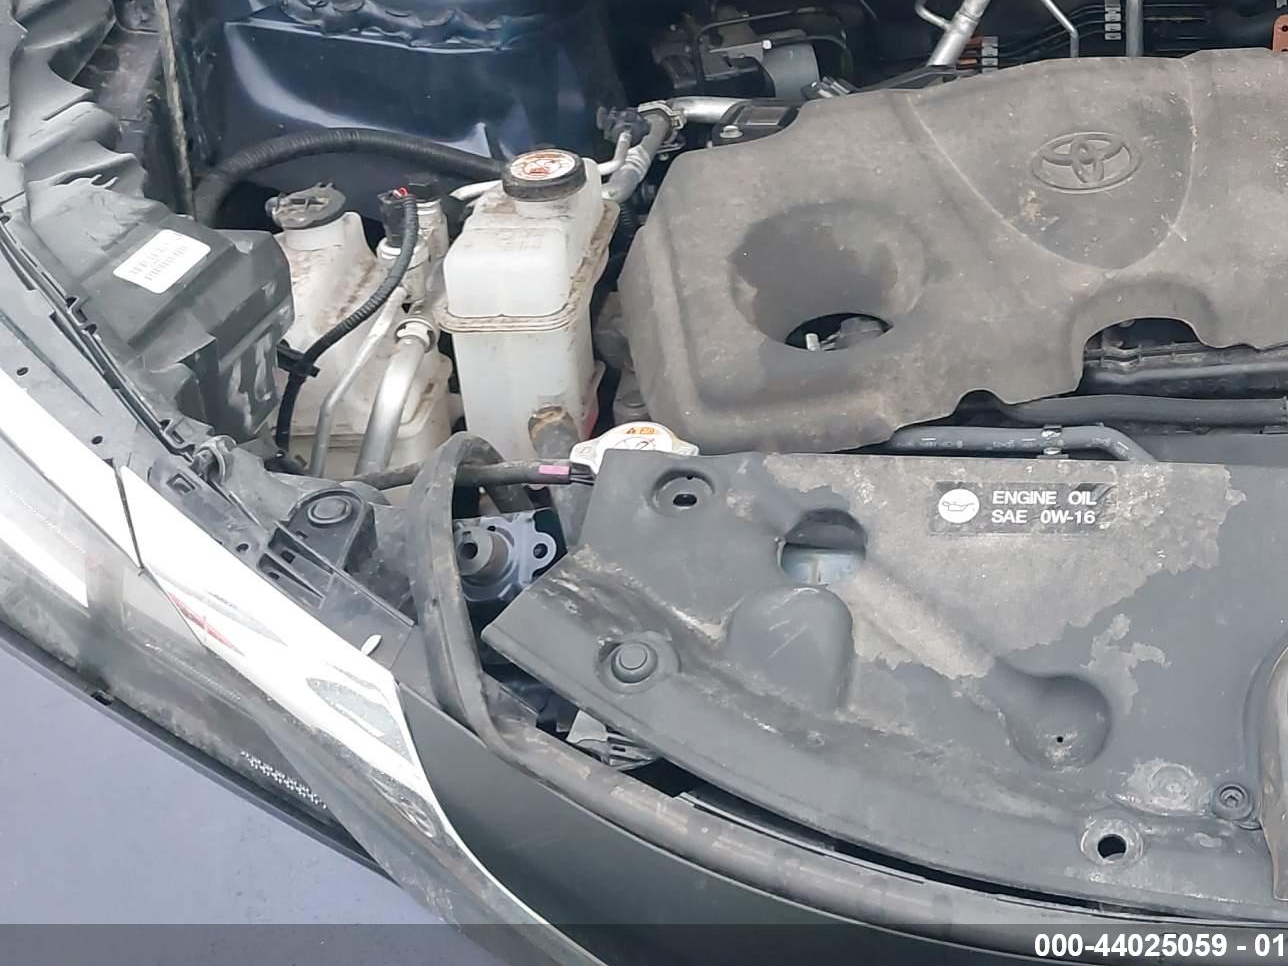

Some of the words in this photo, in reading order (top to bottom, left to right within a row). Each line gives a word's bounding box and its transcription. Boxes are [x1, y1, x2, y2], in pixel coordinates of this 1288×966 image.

[992, 490, 1057, 506] ENGINE
[1067, 490, 1097, 506] OIL
[991, 509, 1027, 524] SAE
[1040, 509, 1096, 525] 0W-16
